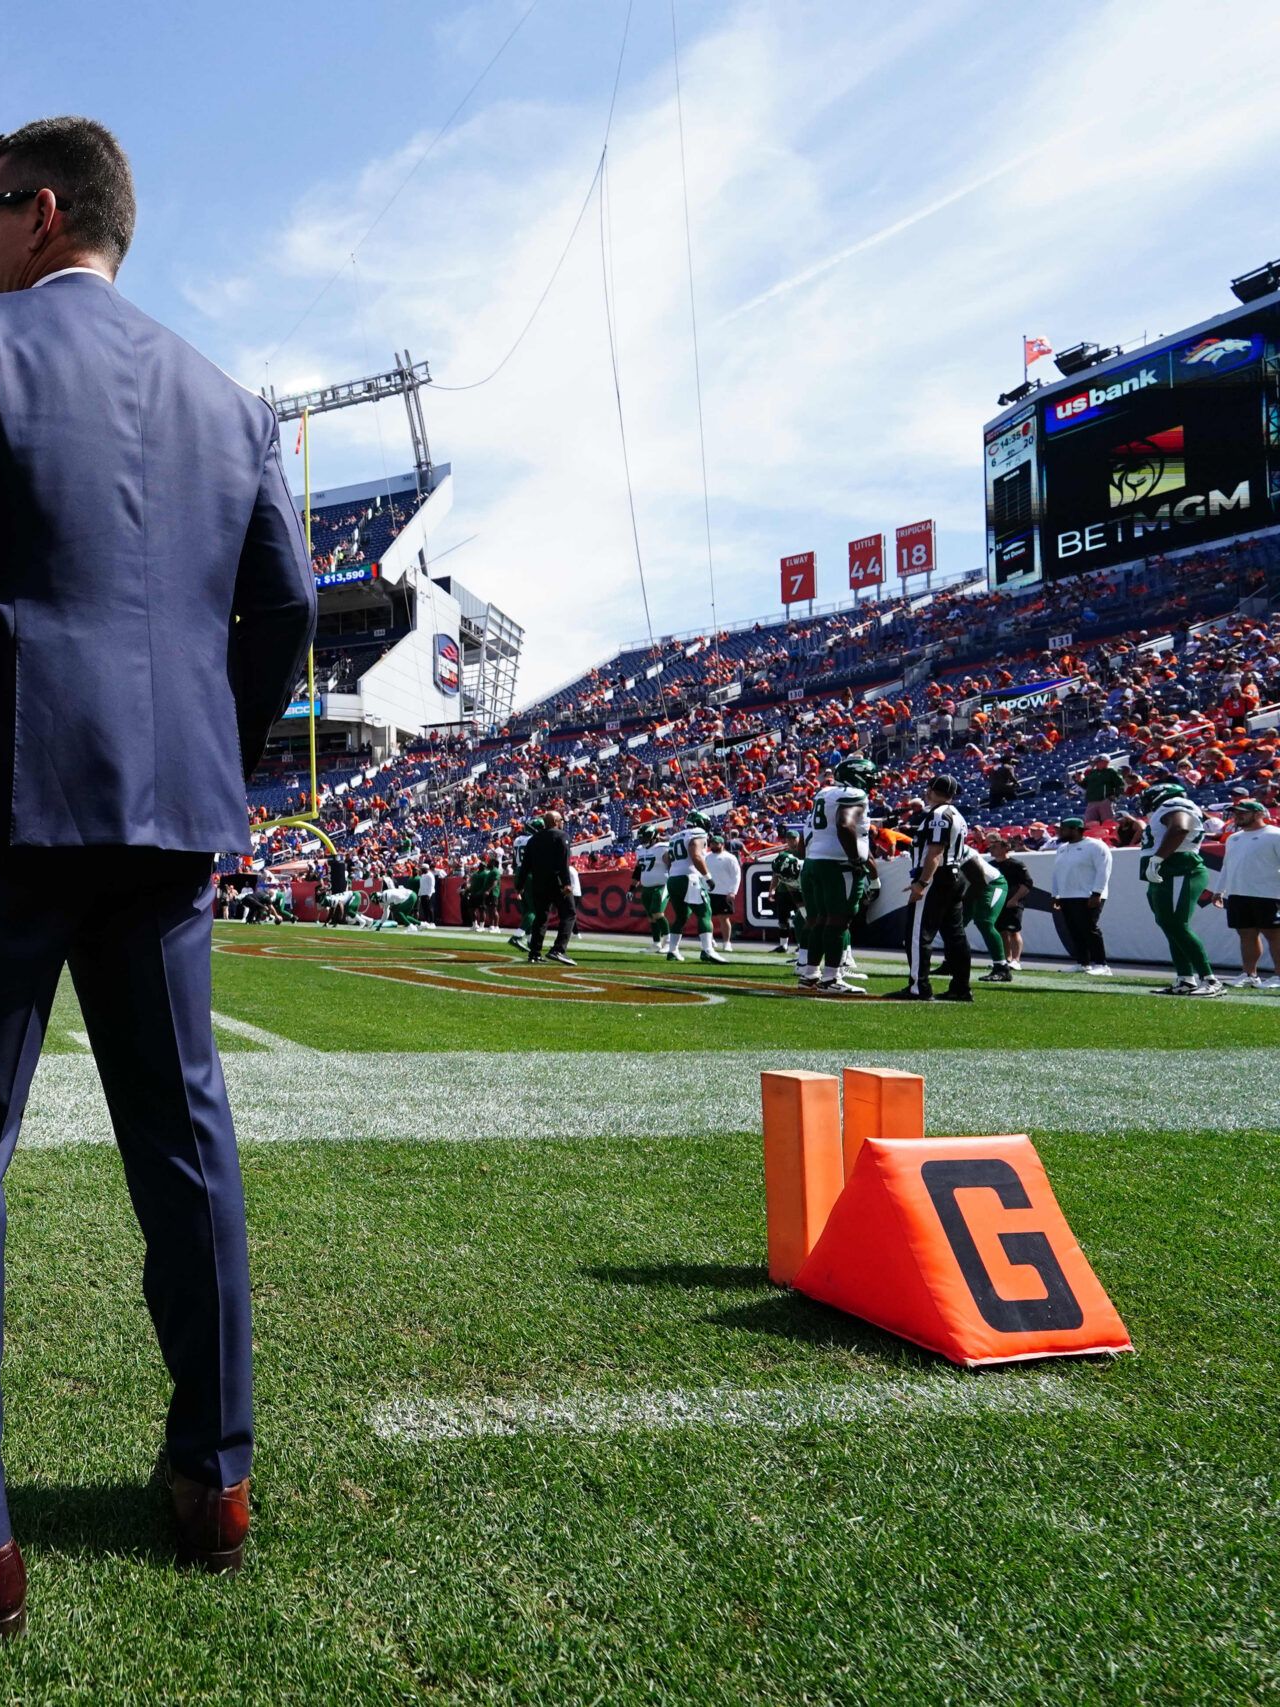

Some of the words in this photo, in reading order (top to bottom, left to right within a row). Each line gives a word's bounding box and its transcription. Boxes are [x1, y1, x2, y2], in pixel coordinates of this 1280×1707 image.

[1023, 435, 1034, 449] 20
[897, 521, 932, 538] TRIPUCKA
[854, 538, 876, 551] LITTLE
[786, 555, 809, 567] ELWAY
[902, 544, 928, 569] 18
[850, 557, 881, 580] 44
[324, 570, 365, 584] $13,590
[790, 574, 804, 595] 7
[1051, 636, 1070, 648] 131
[790, 690, 803, 698] 130
[283, 705, 311, 715] EICO
[930, 820, 946, 828] 40
[920, 1158, 1085, 1334] G
